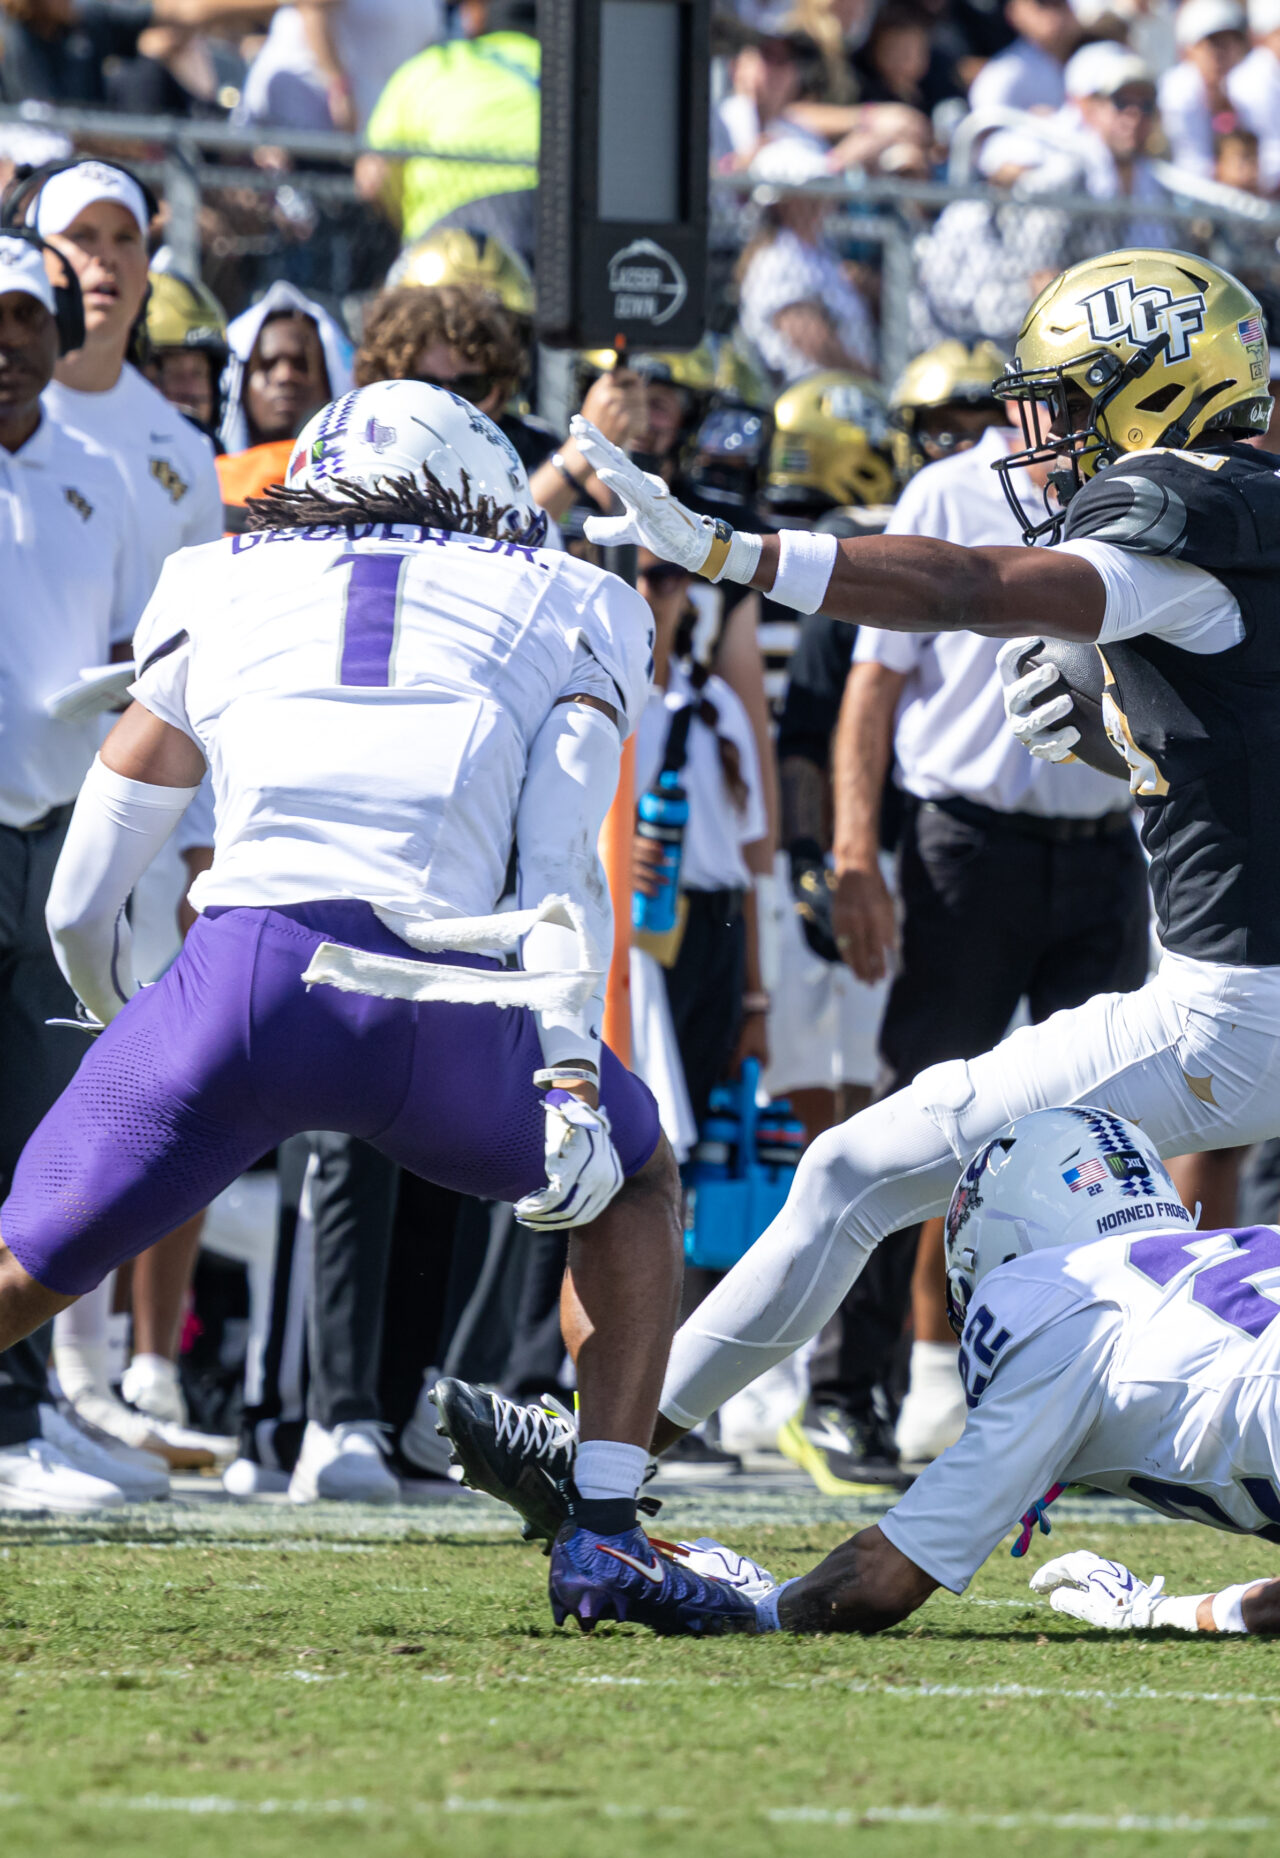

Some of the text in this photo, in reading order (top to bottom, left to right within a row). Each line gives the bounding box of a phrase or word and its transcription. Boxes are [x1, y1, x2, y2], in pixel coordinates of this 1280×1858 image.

[1076, 276, 1208, 367] UCF
[324, 553, 411, 687] 1
[1086, 1182, 1105, 1198] 22
[1096, 1202, 1190, 1234] HORNED FROGS
